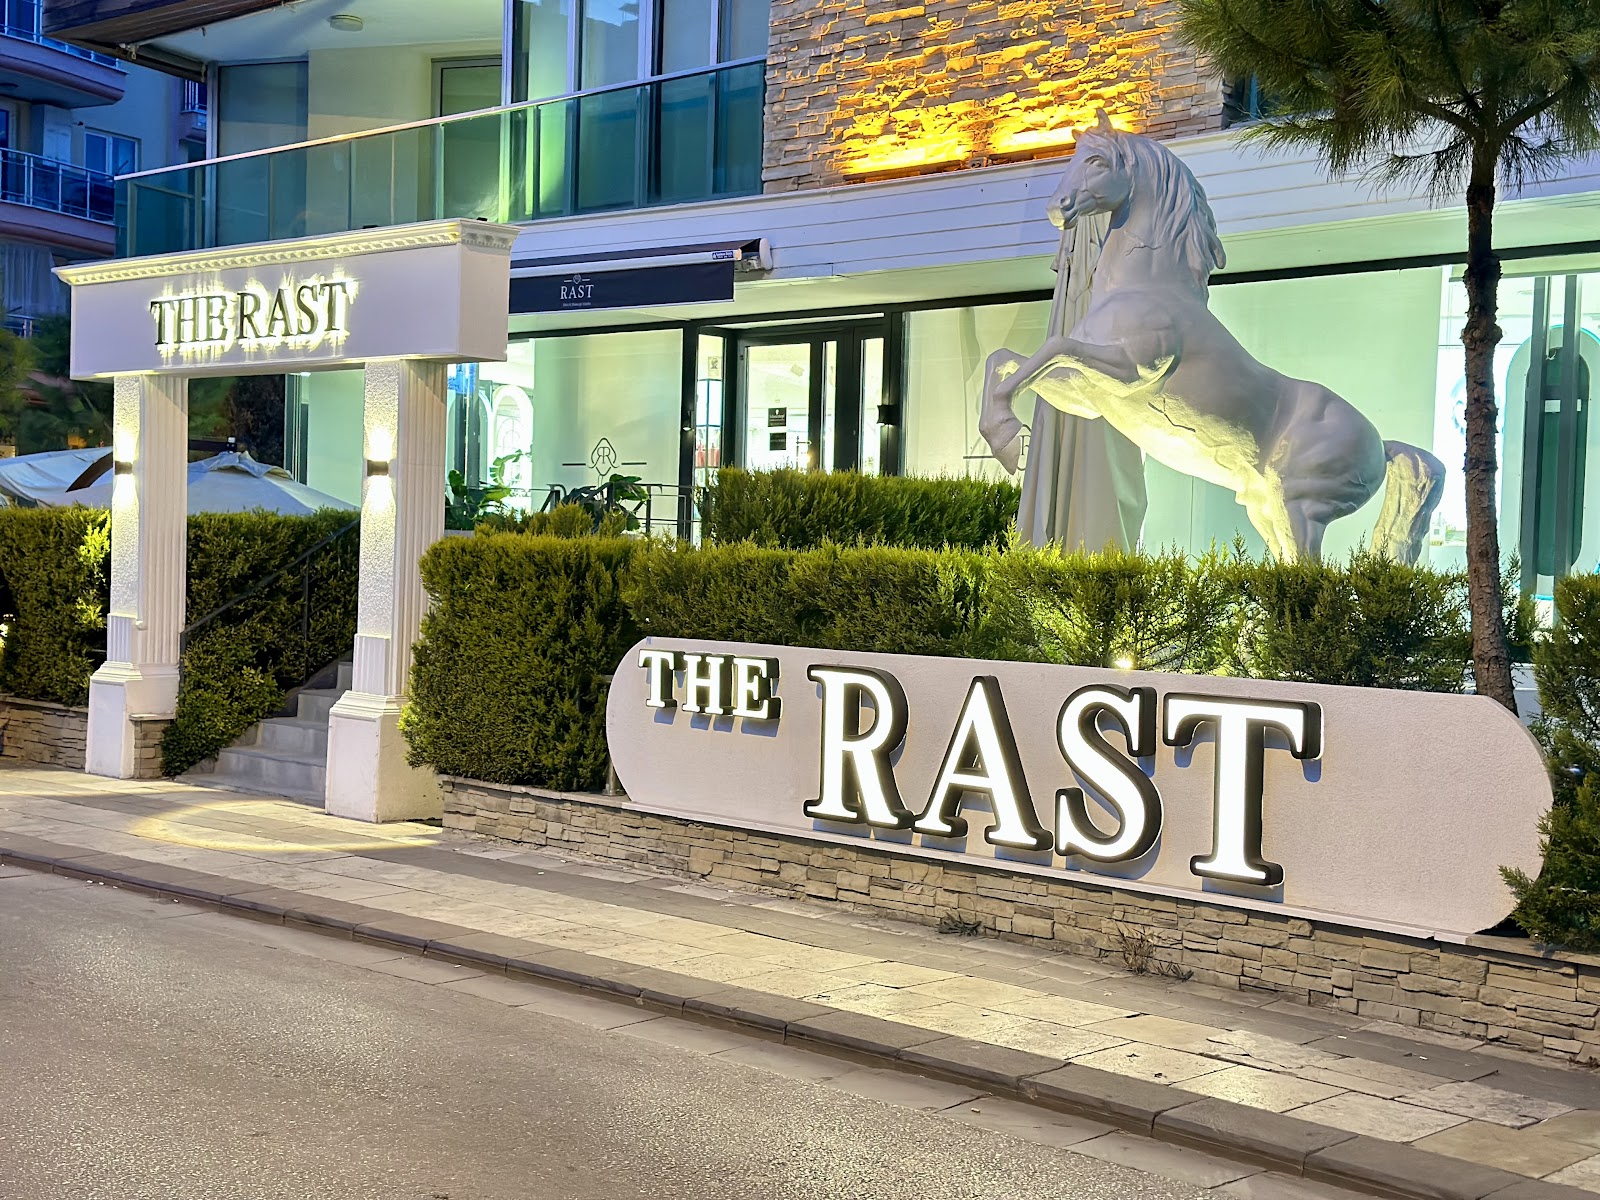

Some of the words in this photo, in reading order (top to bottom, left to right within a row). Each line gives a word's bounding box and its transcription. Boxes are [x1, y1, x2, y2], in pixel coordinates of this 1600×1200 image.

[150, 294, 229, 346] THE
[236, 280, 348, 341] RAST
[560, 284, 595, 300] RAST
[638, 648, 784, 720] THE
[802, 663, 1325, 887] RAST
